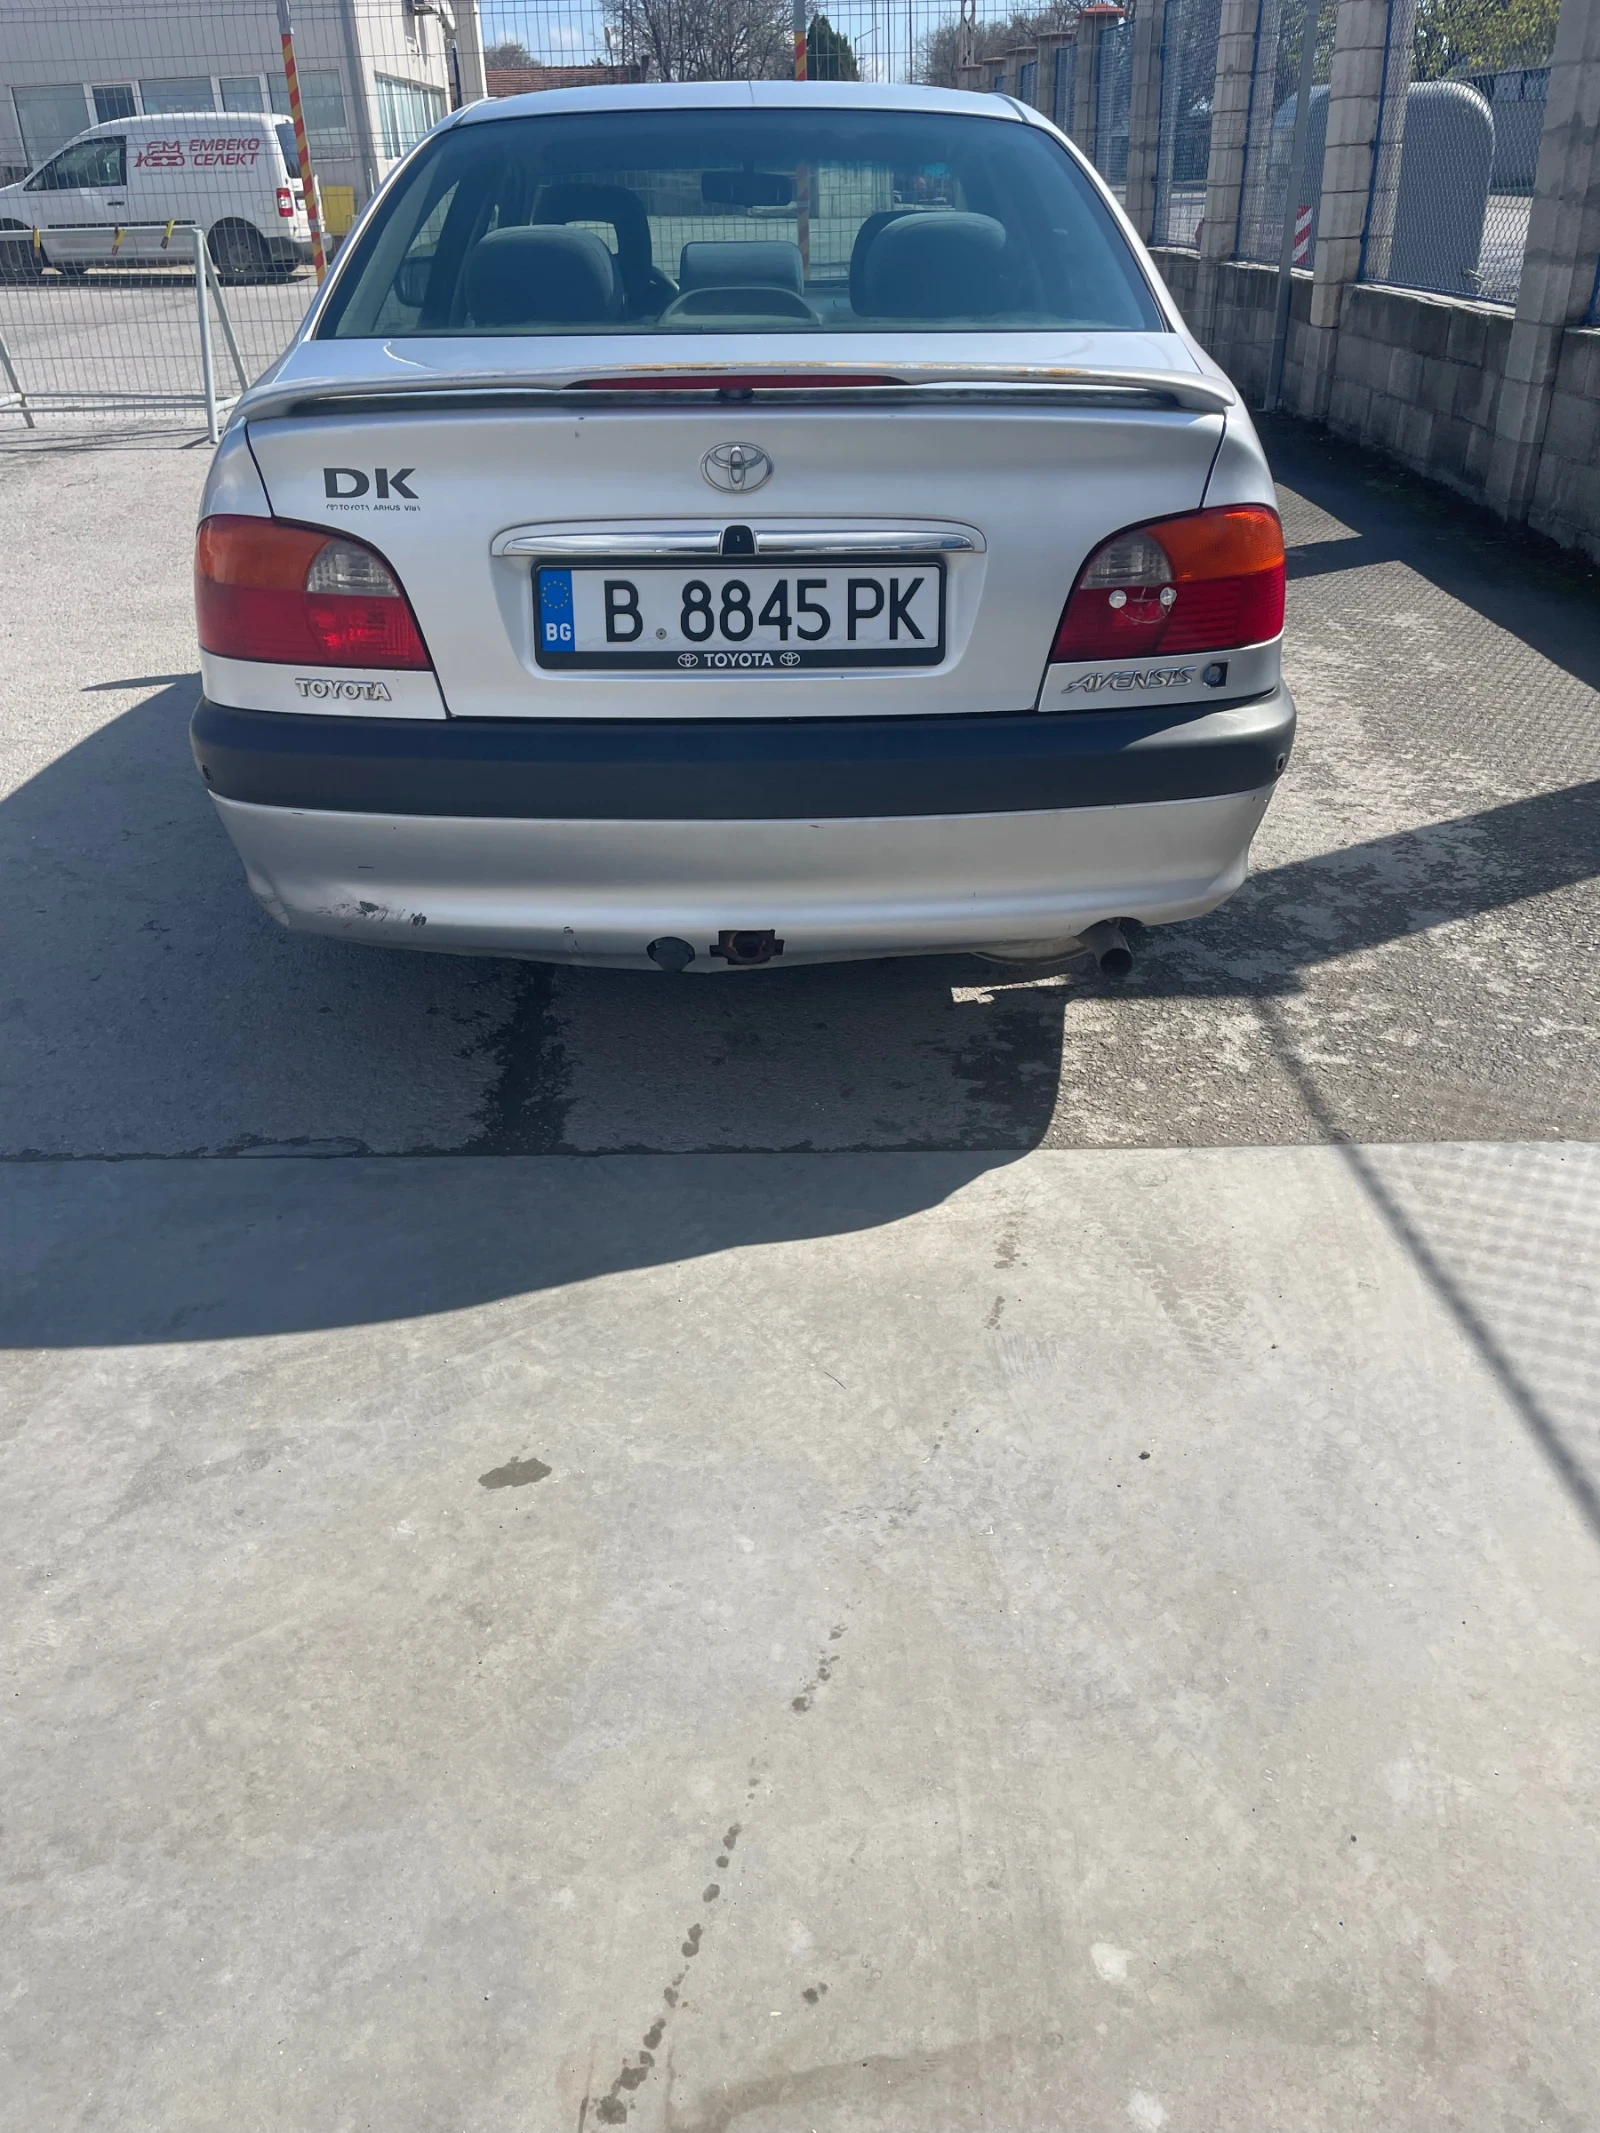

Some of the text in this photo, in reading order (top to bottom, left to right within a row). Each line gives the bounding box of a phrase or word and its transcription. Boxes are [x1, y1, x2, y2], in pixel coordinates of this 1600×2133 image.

[188, 138, 260, 151] ЕМВЕКО
[193, 153, 259, 166] СЕЛЕКТ
[323, 467, 420, 499] DK
[604, 580, 643, 642] B
[680, 578, 832, 643] 8845
[545, 622, 572, 641] BG
[703, 652, 774, 667] TOYOTA
[294, 678, 392, 701] TOYOTA
[1061, 666, 1197, 694] AVENSIS
